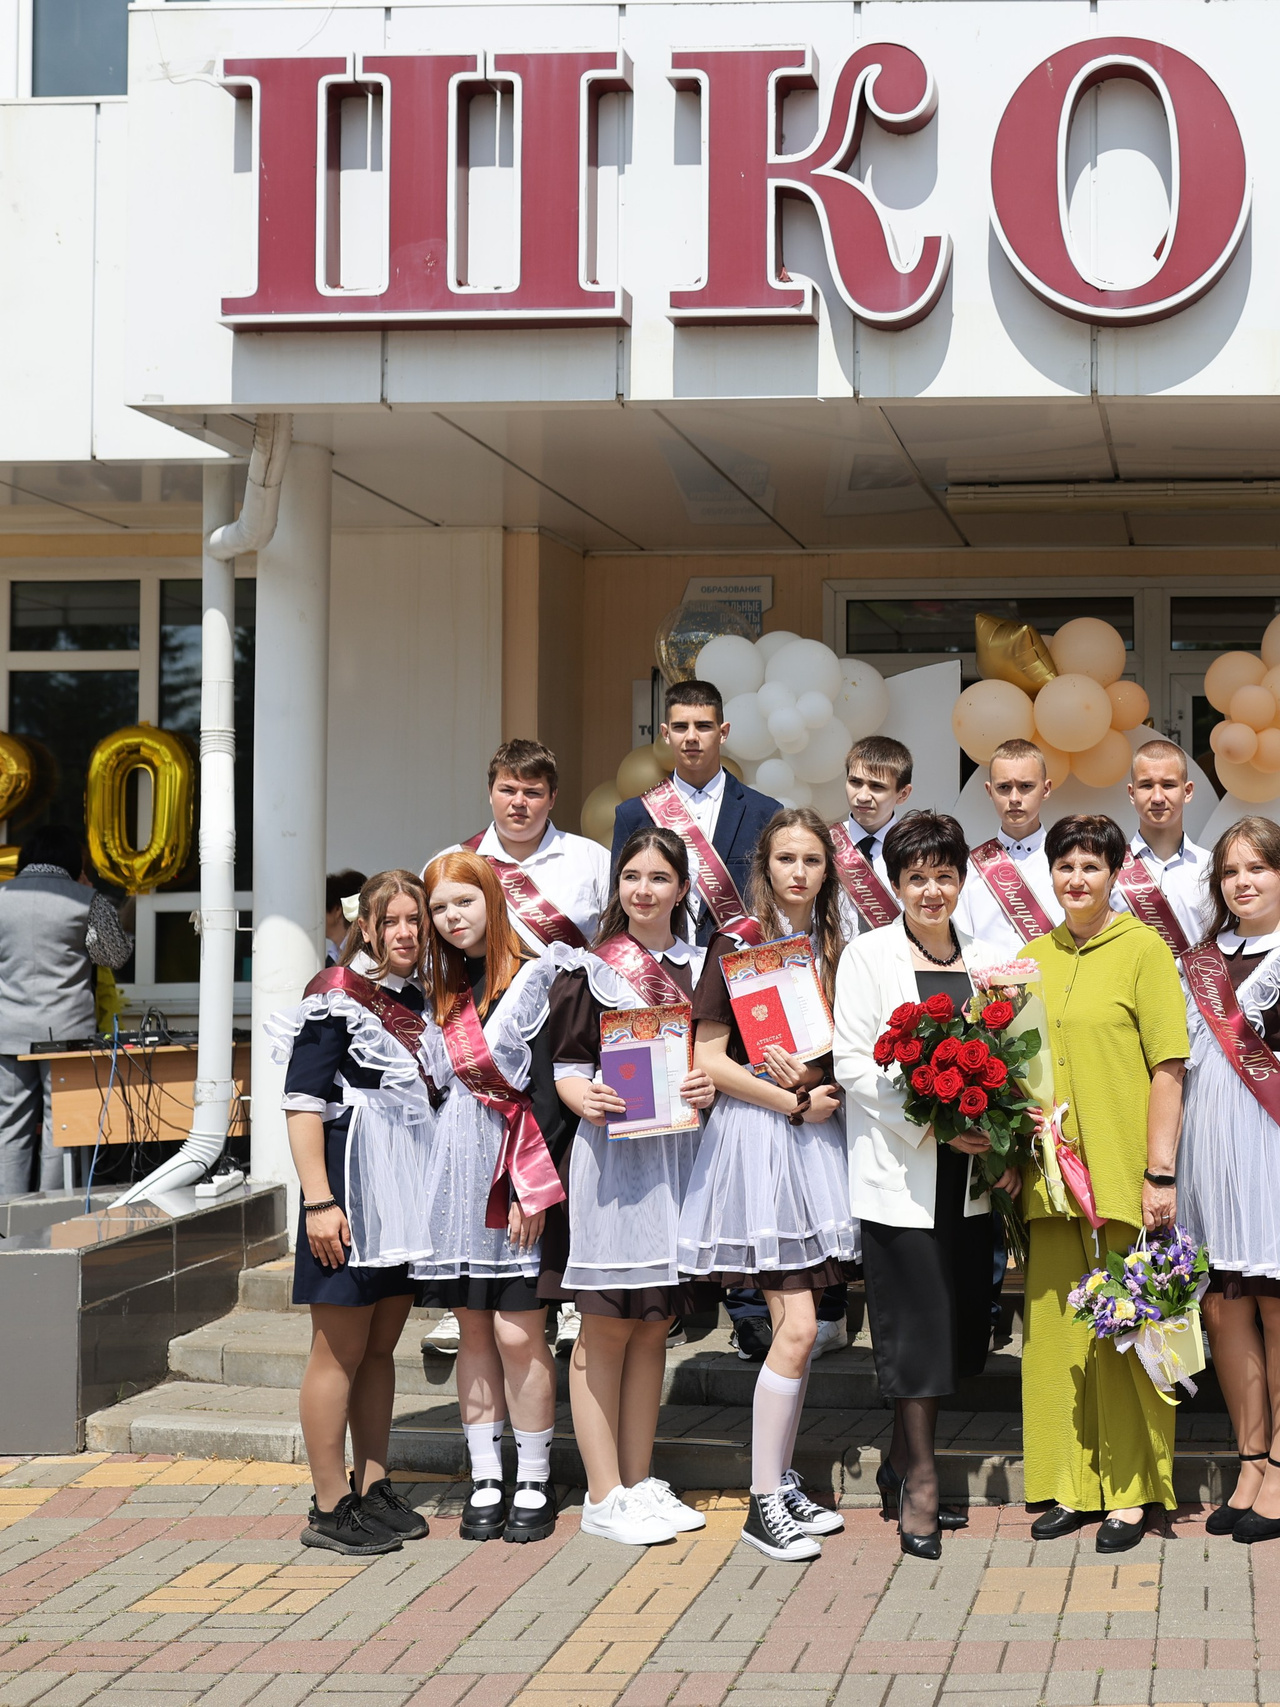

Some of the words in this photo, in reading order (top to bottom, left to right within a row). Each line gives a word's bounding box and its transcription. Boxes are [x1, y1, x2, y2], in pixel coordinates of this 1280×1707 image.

[701, 584, 763, 594] ОБРАЗОВАНИЕ
[690, 601, 761, 612] НАЦИАЛЬНЫЕ
[719, 612, 761, 624] ПРОКТЫ
[1190, 956, 1246, 1050] Выпускница
[1238, 1049, 1279, 1082] 2025
[447, 992, 485, 1078] ыпускница
